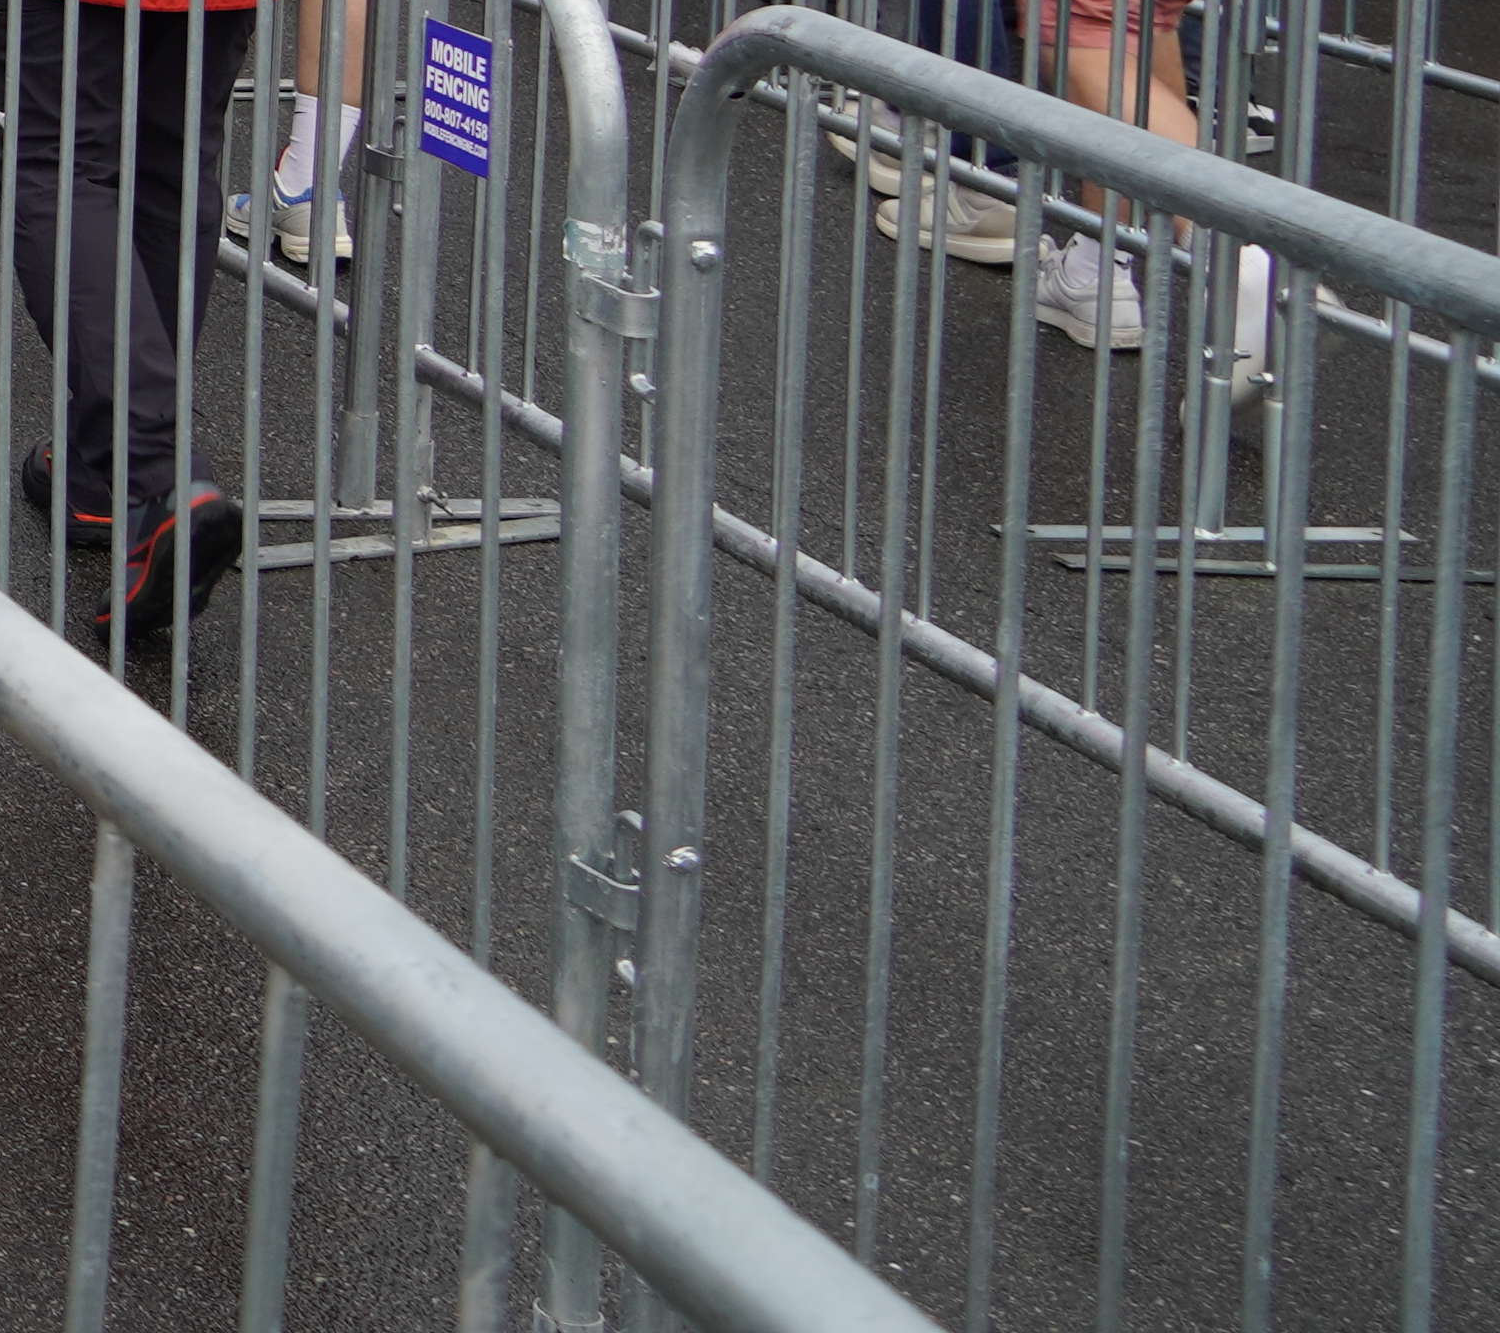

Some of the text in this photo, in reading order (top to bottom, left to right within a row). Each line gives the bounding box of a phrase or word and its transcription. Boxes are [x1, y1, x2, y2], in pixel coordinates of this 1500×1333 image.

[431, 37, 487, 83] MOBILE
[426, 64, 490, 113] FENCING
[424, 98, 488, 142] 800-807-4158
